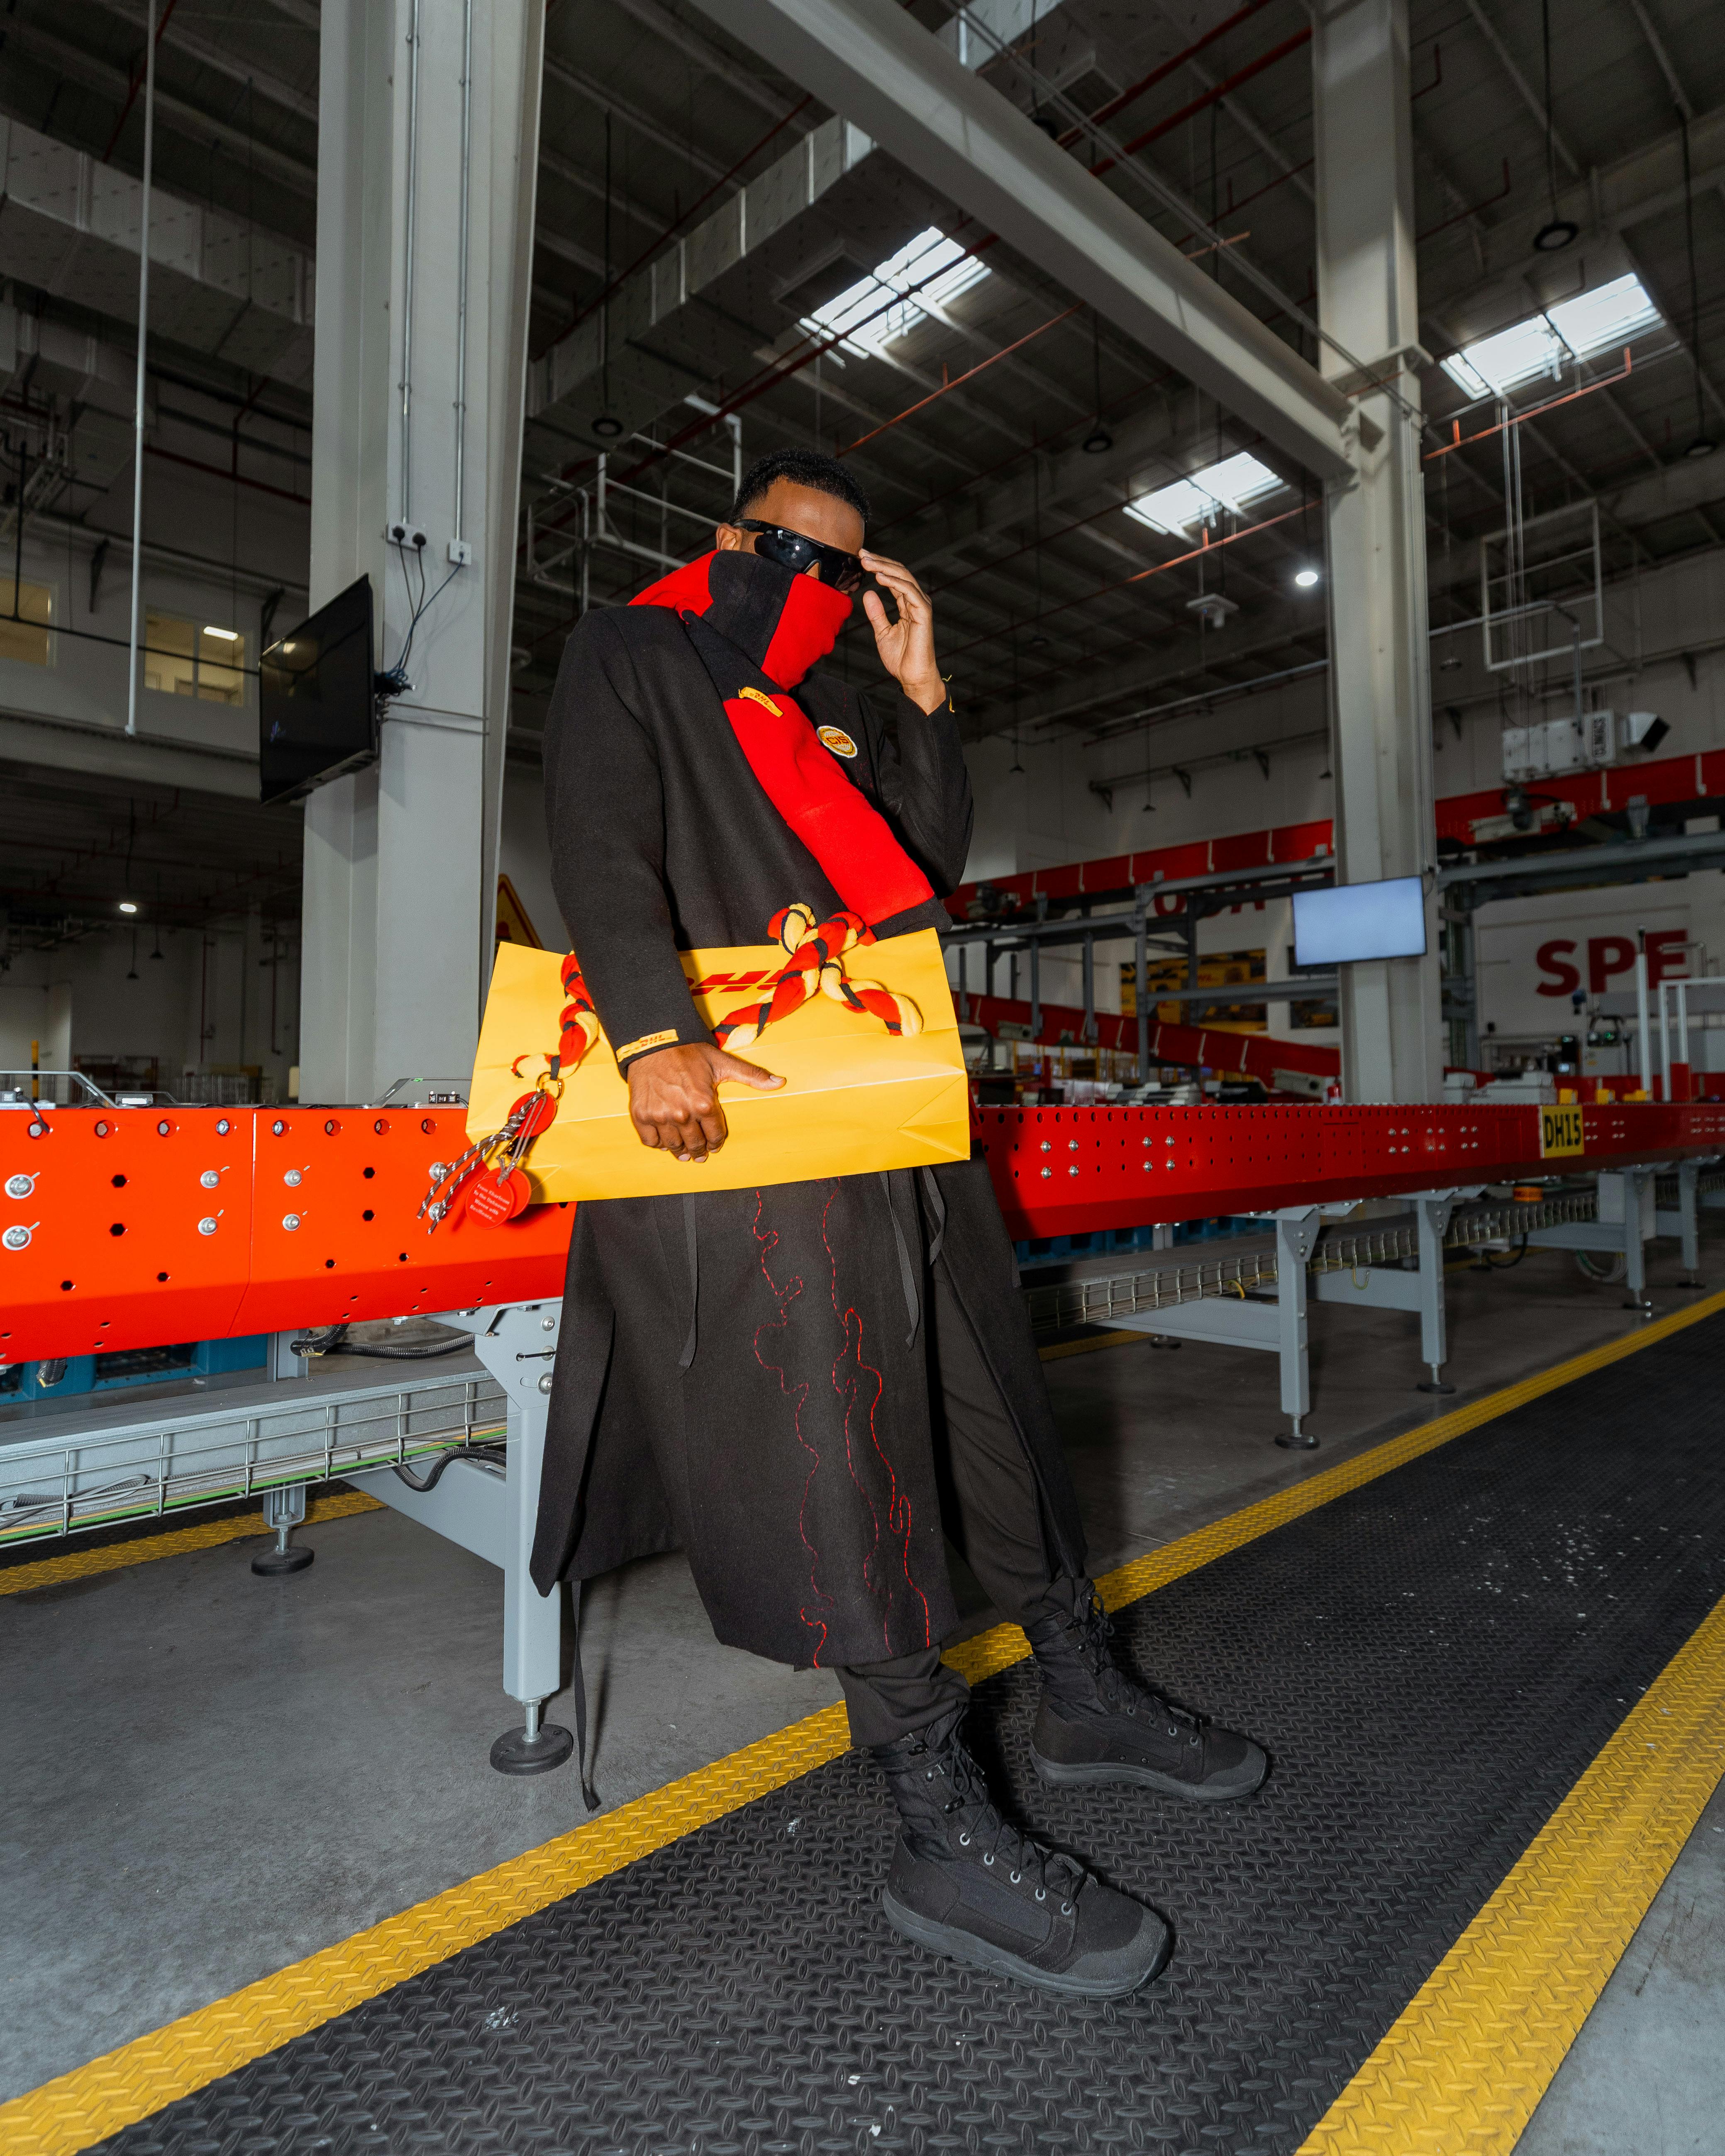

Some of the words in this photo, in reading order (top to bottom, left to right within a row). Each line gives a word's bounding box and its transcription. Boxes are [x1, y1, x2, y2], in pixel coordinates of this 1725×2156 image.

[754, 693, 769, 705] DHL
[826, 736, 849, 744] CIS
[639, 1035, 665, 1047] DHL
[1544, 1113, 1581, 1149] DH15
